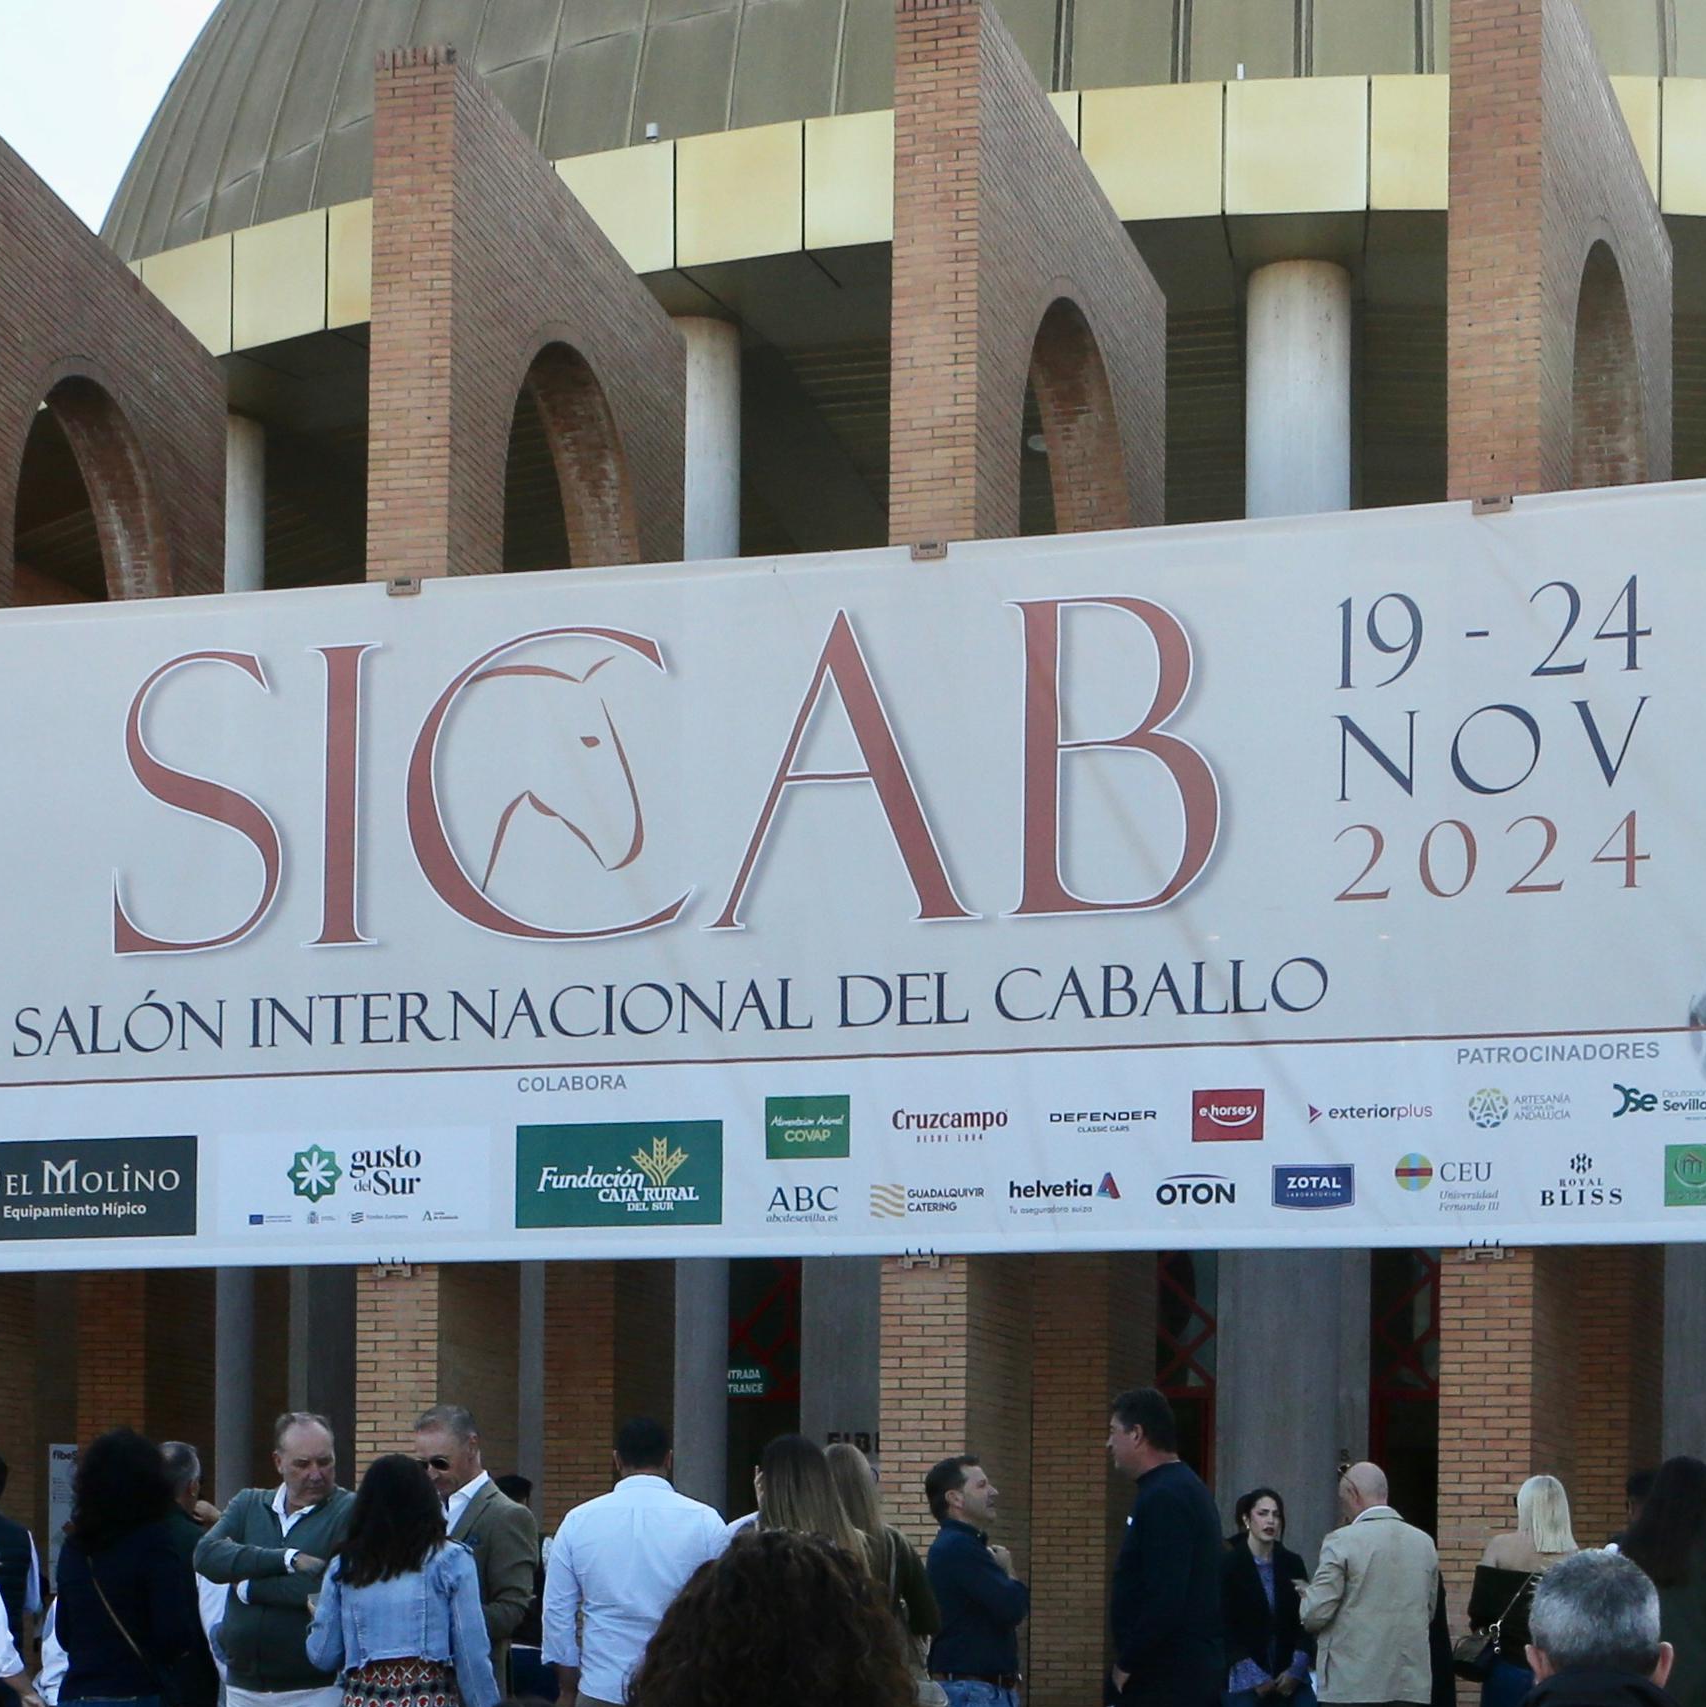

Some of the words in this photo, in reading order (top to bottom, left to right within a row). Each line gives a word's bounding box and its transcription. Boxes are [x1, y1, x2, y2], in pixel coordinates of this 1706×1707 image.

[1335, 592, 1424, 690] 19
[1529, 574, 1653, 678] 24
[1332, 695, 1652, 802] NOV
[112, 595, 1222, 957] SICAB
[1333, 809, 1652, 902] 2024
[12, 989, 226, 1058] SALÓN
[250, 977, 813, 1049] INTERNACIONAL
[837, 970, 969, 1030] DEL
[994, 956, 1329, 1022] CABALLO
[1457, 1042, 1660, 1065] PATROCINADORES
[517, 1074, 627, 1092] COLABORA
[1514, 1092, 1571, 1105] ARTESANÍA
[892, 1108, 1008, 1131] Cruzcampo
[1050, 1110, 1157, 1123] DEFENDER
[1328, 1103, 1433, 1120] exteriorplus
[1514, 1109, 1571, 1120] ANDALUCÍA
[784, 1129, 831, 1142] COVAP
[1077, 1125, 1108, 1133] CLASSIC
[1109, 1124, 1130, 1132] CARS
[350, 1144, 421, 1179] gusto
[537, 1165, 644, 1192] Fundación
[1440, 1161, 1492, 1182] CEU
[5, 1173, 33, 1196] EL
[354, 1178, 371, 1192] del
[372, 1170, 421, 1196] Sur
[1009, 1178, 1093, 1198] helvetia
[1287, 1176, 1342, 1189] ZOTAL
[1559, 1177, 1605, 1187] ROYAL
[597, 1187, 640, 1202] CAJA
[643, 1186, 700, 1201] RURAL
[768, 1185, 839, 1212] ABC
[907, 1187, 985, 1199] GUADALQUIVIR
[1156, 1182, 1235, 1206] OTON
[1439, 1189, 1499, 1200] Universidad
[1540, 1187, 1623, 1207] BLISS
[3, 1203, 99, 1221] Equipamiento
[102, 1202, 147, 1218] Hípico
[627, 1202, 649, 1211] DEL
[652, 1201, 674, 1211] SUR
[907, 1201, 958, 1212] CATERING
[1009, 1205, 1018, 1214] Tu
[1020, 1205, 1069, 1216] aseguradora
[1071, 1205, 1093, 1214] suiza
[1439, 1201, 1486, 1212] Fernando
[1488, 1201, 1500, 1211] III
[765, 1212, 838, 1223] abcdesevilla.es
